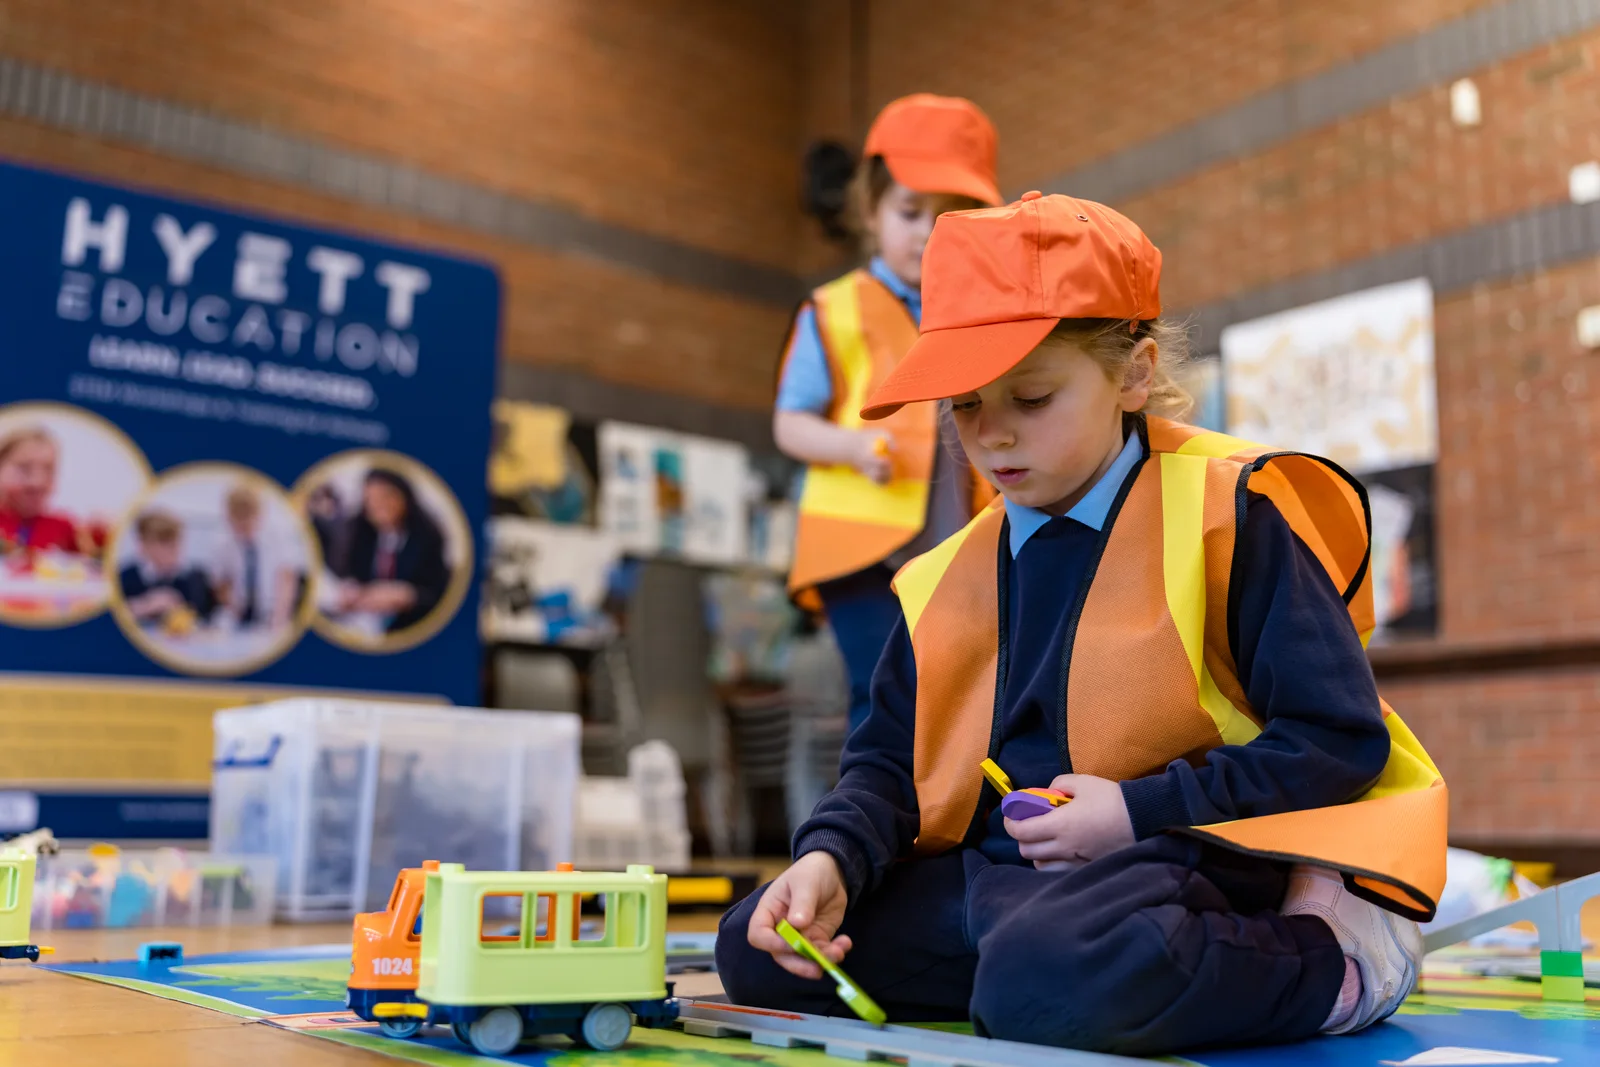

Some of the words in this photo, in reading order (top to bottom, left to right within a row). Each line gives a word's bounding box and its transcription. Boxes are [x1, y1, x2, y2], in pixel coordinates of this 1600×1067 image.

[61, 197, 431, 329] HYETT
[57, 270, 419, 377] EDUCATION
[371, 957, 412, 976] 1024
